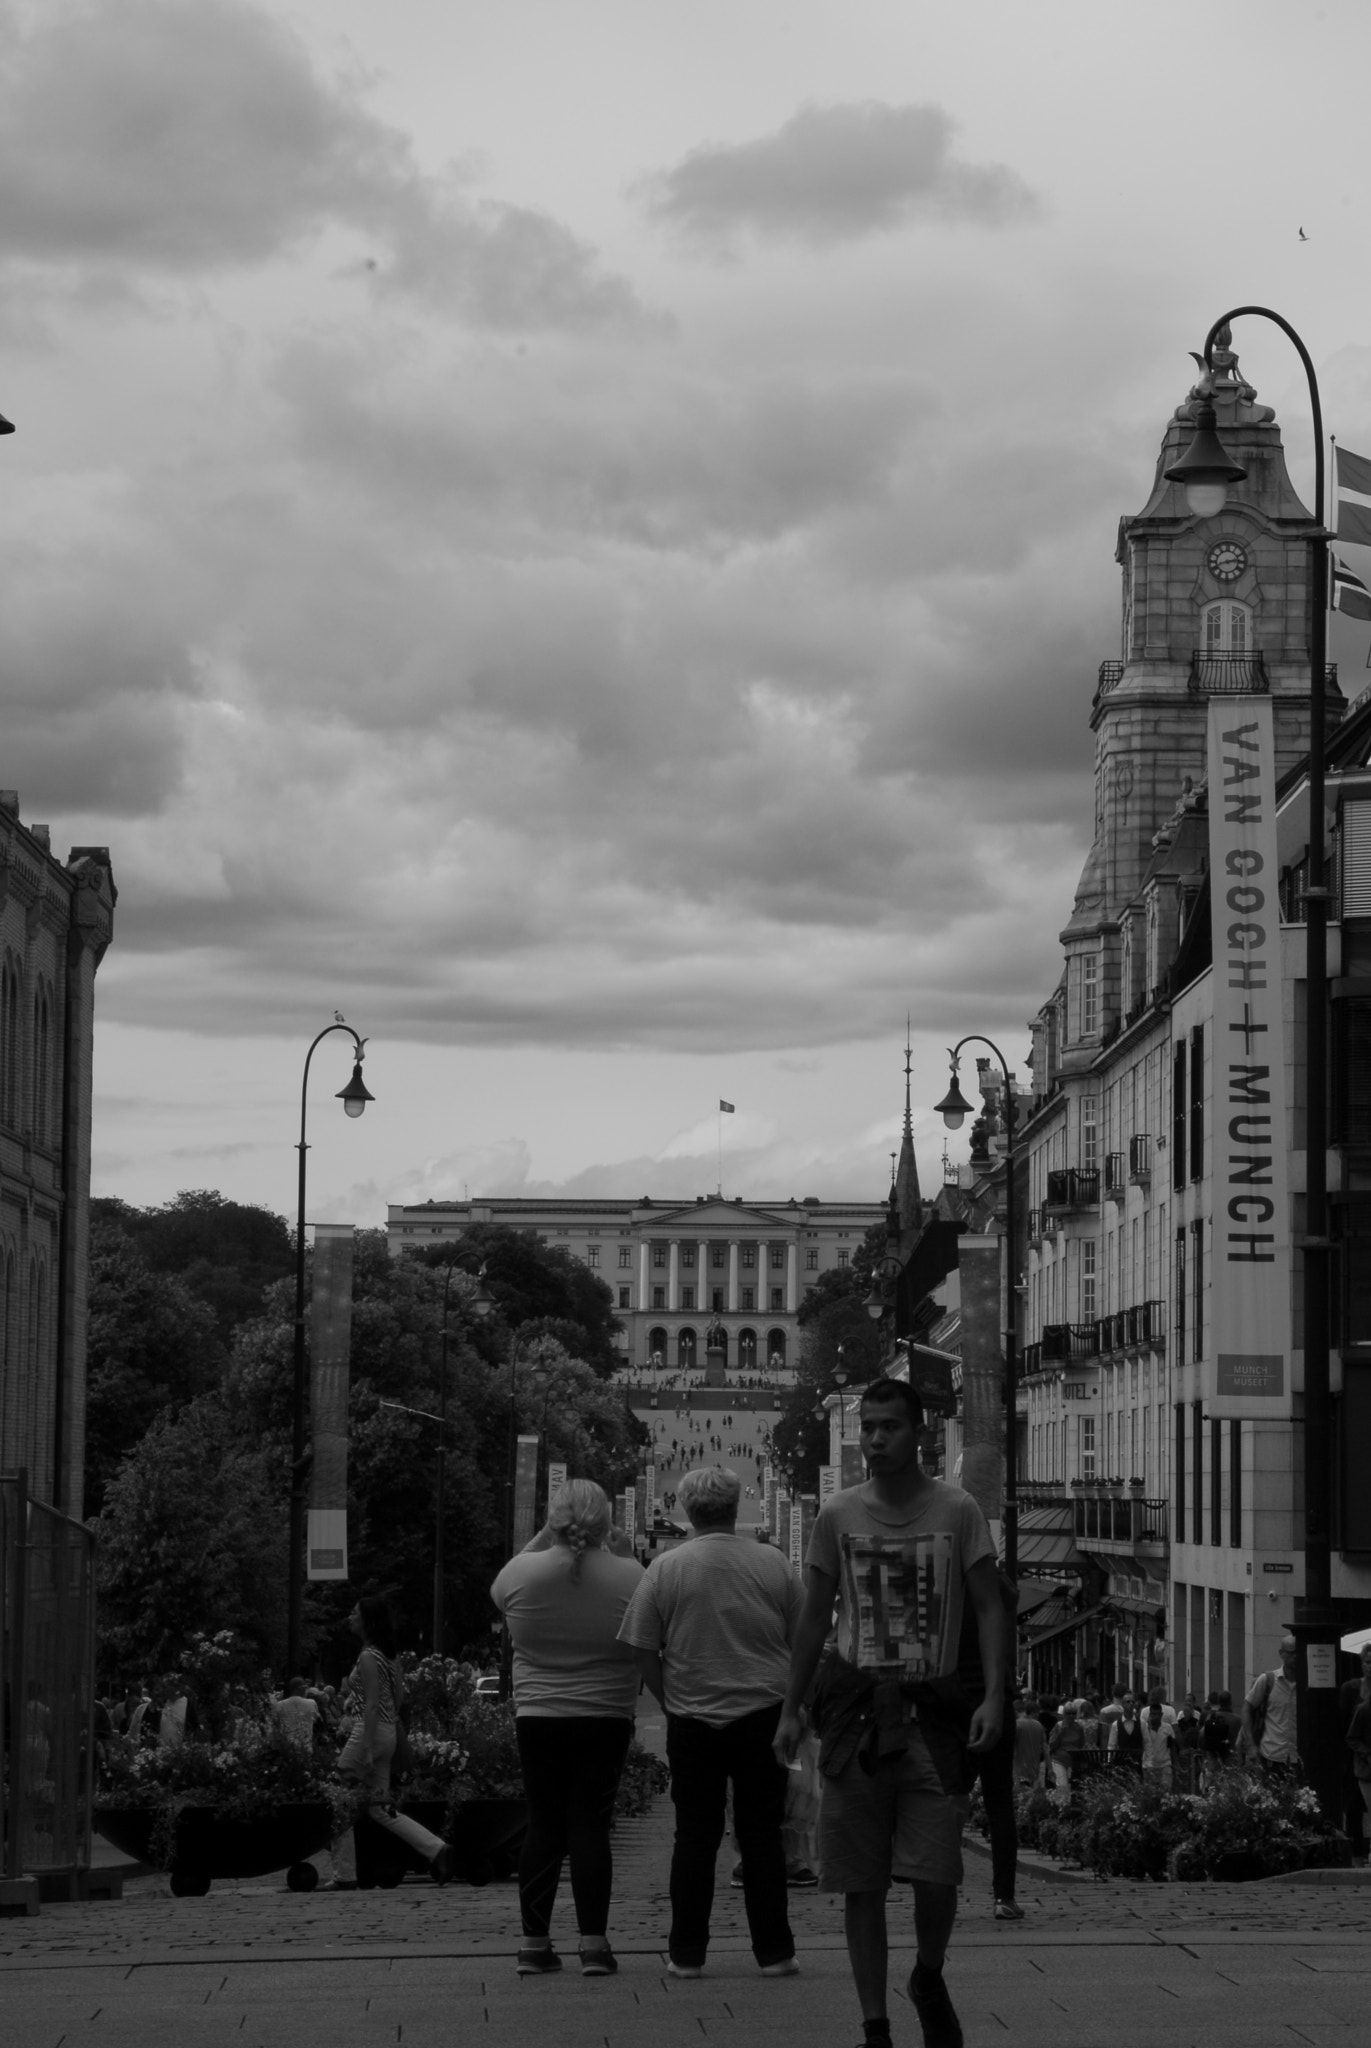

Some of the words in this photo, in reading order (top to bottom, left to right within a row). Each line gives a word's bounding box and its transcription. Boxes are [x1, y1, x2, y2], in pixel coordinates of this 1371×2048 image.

[1222, 722, 1262, 824] VAN
[1225, 849, 1267, 989] GOGH
[1227, 1065, 1275, 1262] MUNCH
[1233, 1365, 1268, 1375] MUNCH
[1233, 1378, 1268, 1387] MUSEET
[823, 1472, 834, 1494] VAN
[792, 1509, 800, 1526] VAN
[792, 1528, 800, 1551] GOGH
